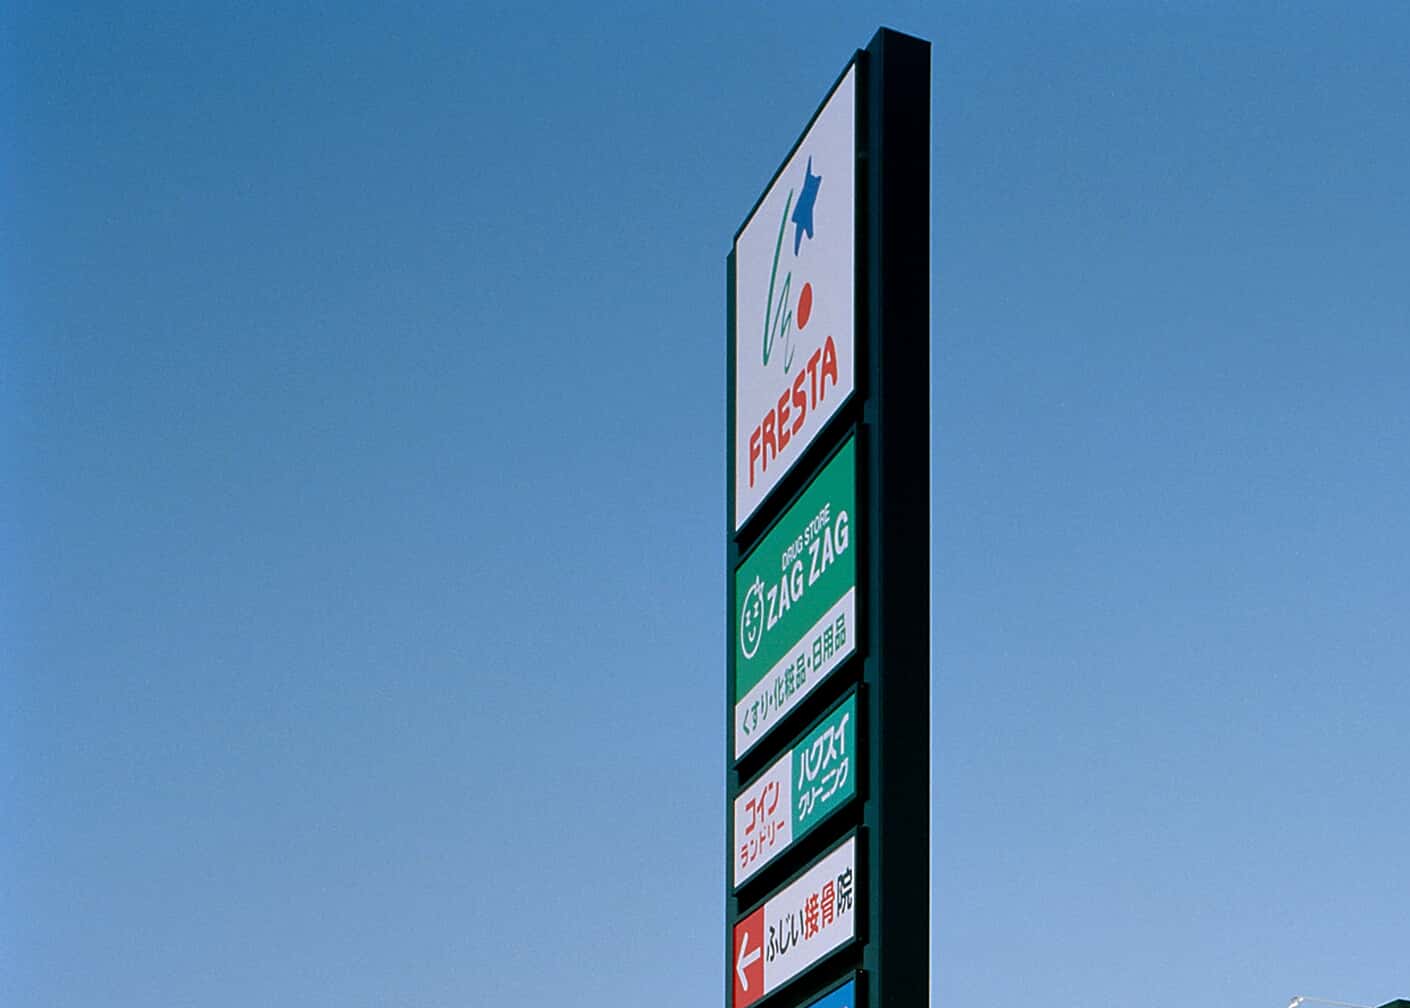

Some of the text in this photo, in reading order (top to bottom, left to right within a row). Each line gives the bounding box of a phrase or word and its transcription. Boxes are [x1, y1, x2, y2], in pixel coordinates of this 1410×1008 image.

[748, 335, 838, 488] FRESTA
[767, 510, 849, 631] ZAG ZAG
[782, 503, 831, 571] DRUG STORE
[798, 712, 850, 790] ハクスイ
[745, 781, 780, 836] コイン
[798, 757, 849, 821] クリーニング
[740, 821, 785, 868] ランドリー
[766, 867, 853, 962] ふじい接骨院
